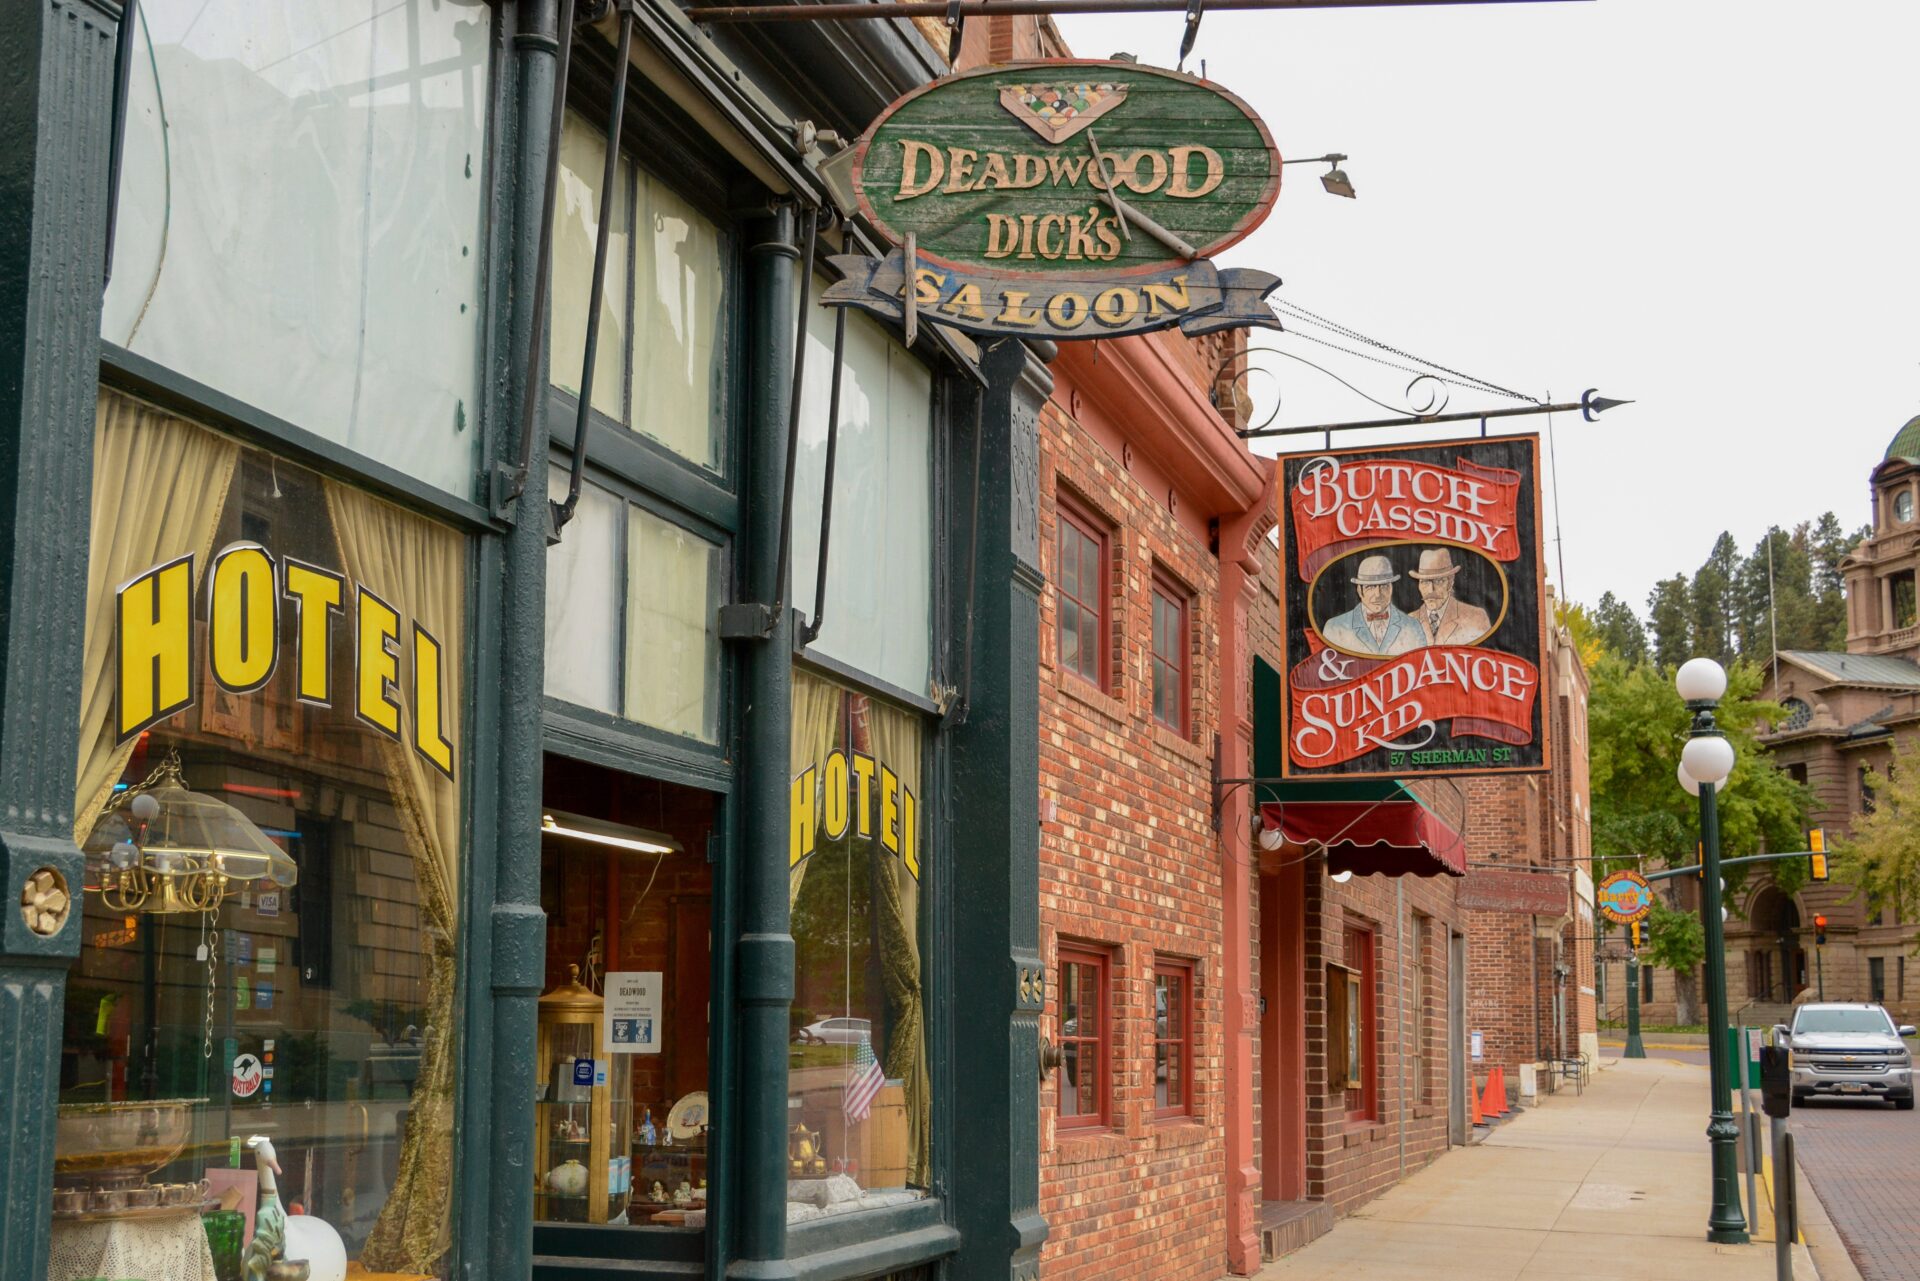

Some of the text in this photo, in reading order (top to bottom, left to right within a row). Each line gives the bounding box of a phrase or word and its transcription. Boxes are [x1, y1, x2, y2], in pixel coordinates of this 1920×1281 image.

[893, 139, 1225, 202] DEADWOOD
[984, 206, 1122, 262] DICK'S
[901, 267, 1191, 330] SALOON
[1298, 456, 1498, 521] BUTCH
[1336, 499, 1507, 552] CASSIDY
[115, 540, 455, 783] HOTEL
[1317, 648, 1355, 682] &
[1295, 649, 1534, 759] SUNDANCE
[1353, 700, 1436, 751] KID
[1390, 747, 1512, 766] 57 SHERMAN ST
[790, 749, 921, 886] HOTEL
[260, 896, 277, 906] VISA
[619, 988, 646, 996] DEADWOOD
